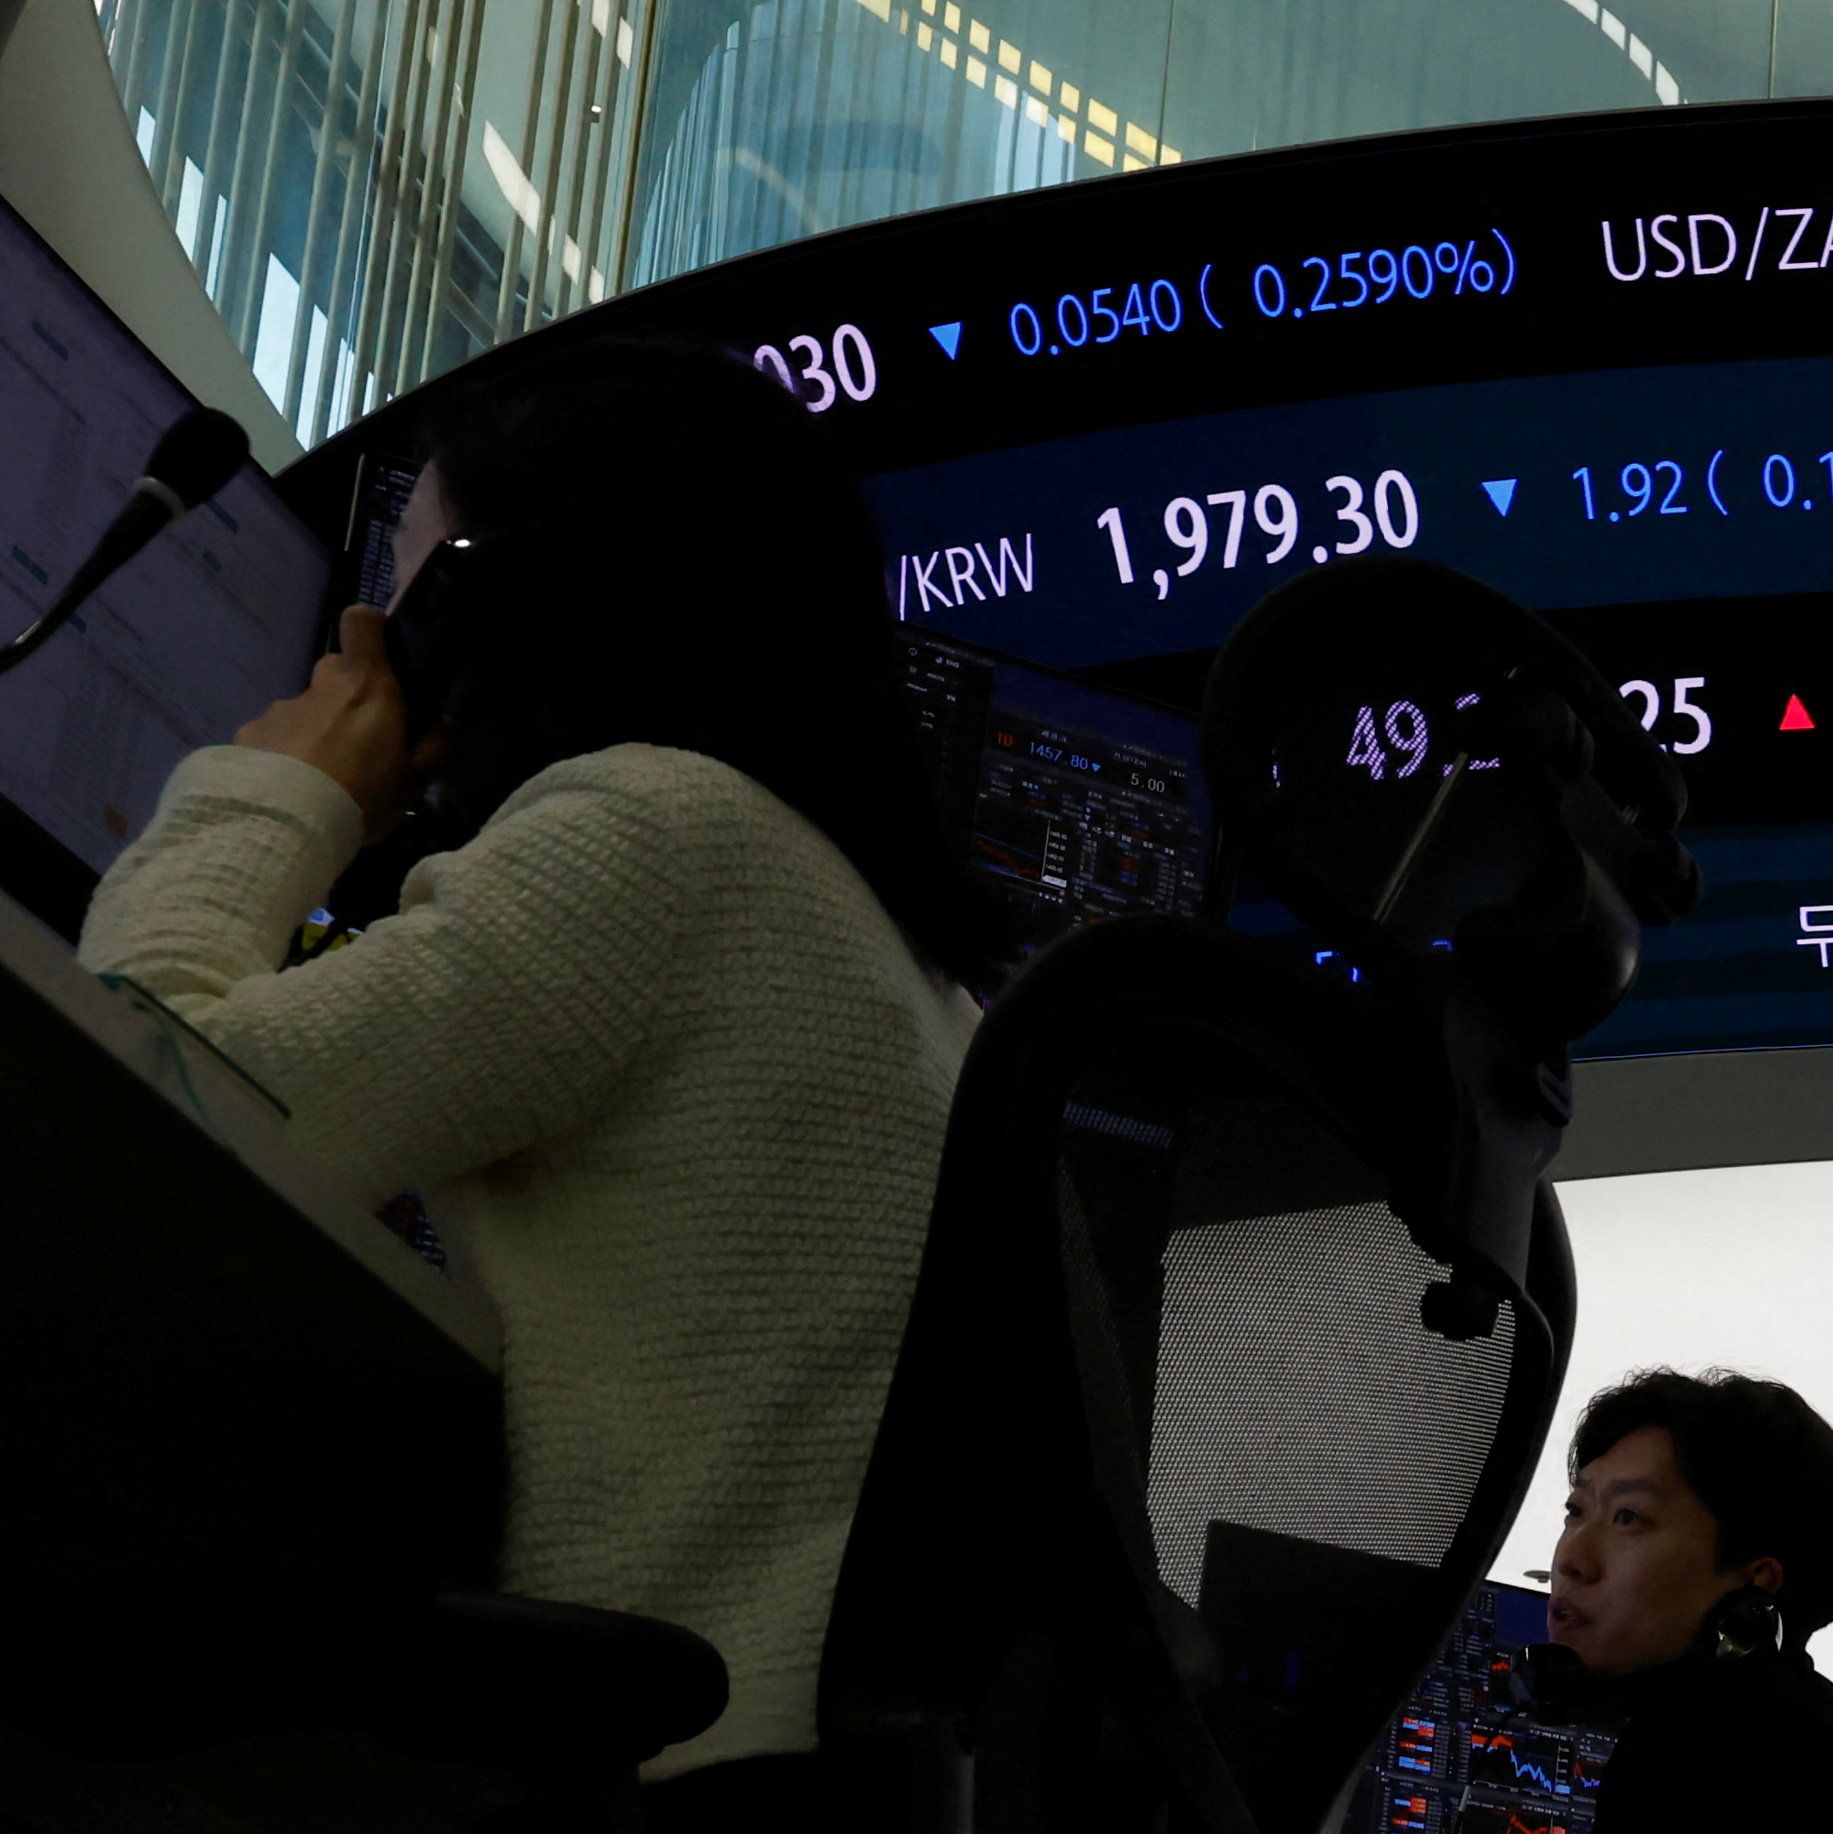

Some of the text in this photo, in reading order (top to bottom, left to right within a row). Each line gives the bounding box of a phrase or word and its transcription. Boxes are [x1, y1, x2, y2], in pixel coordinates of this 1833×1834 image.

[1009, 278, 1183, 356] 0.0540
[1096, 469, 1419, 601] 1,979.30
[1572, 459, 1690, 523] 1.92
[1028, 740, 1090, 770] 1457.80
[1129, 773, 1166, 794] 5.00
